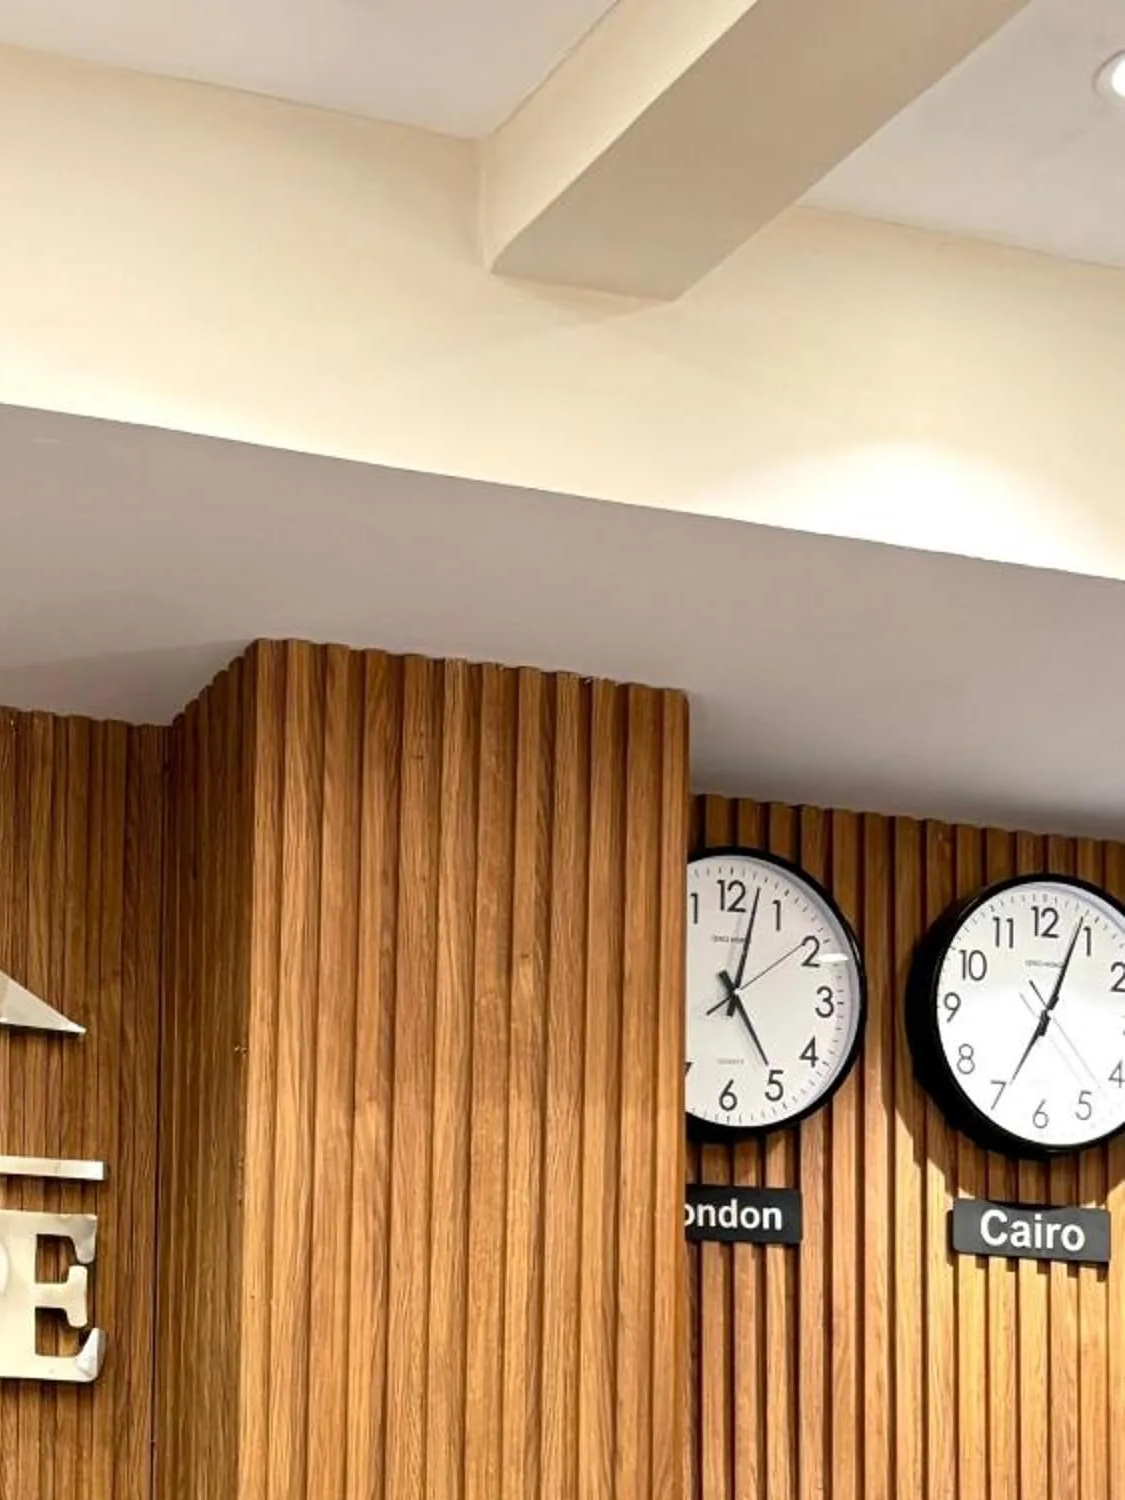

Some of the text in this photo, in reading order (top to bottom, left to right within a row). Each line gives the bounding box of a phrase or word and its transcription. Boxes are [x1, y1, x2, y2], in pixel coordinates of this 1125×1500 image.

[717, 880, 747, 913] 12
[772, 899, 782, 932] 1
[992, 915, 1015, 949] 11
[1030, 905, 1060, 939] 12
[800, 935, 821, 968] 2
[1083, 926, 1093, 957] 1
[958, 949, 988, 982] 10
[1109, 961, 1125, 993] 2
[814, 985, 835, 1018] 3
[943, 991, 962, 1023] 9
[799, 1035, 819, 1068] 4
[956, 1043, 976, 1075] 8
[764, 1069, 785, 1102] 5
[1107, 1059, 1125, 1089] 4
[718, 1078, 738, 1111] 6
[990, 1079, 1007, 1111] 7
[1074, 1089, 1093, 1121] 5
[1032, 1098, 1050, 1129] 6
[683, 1197, 783, 1231] ondon
[980, 1208, 1086, 1252] Cairo
